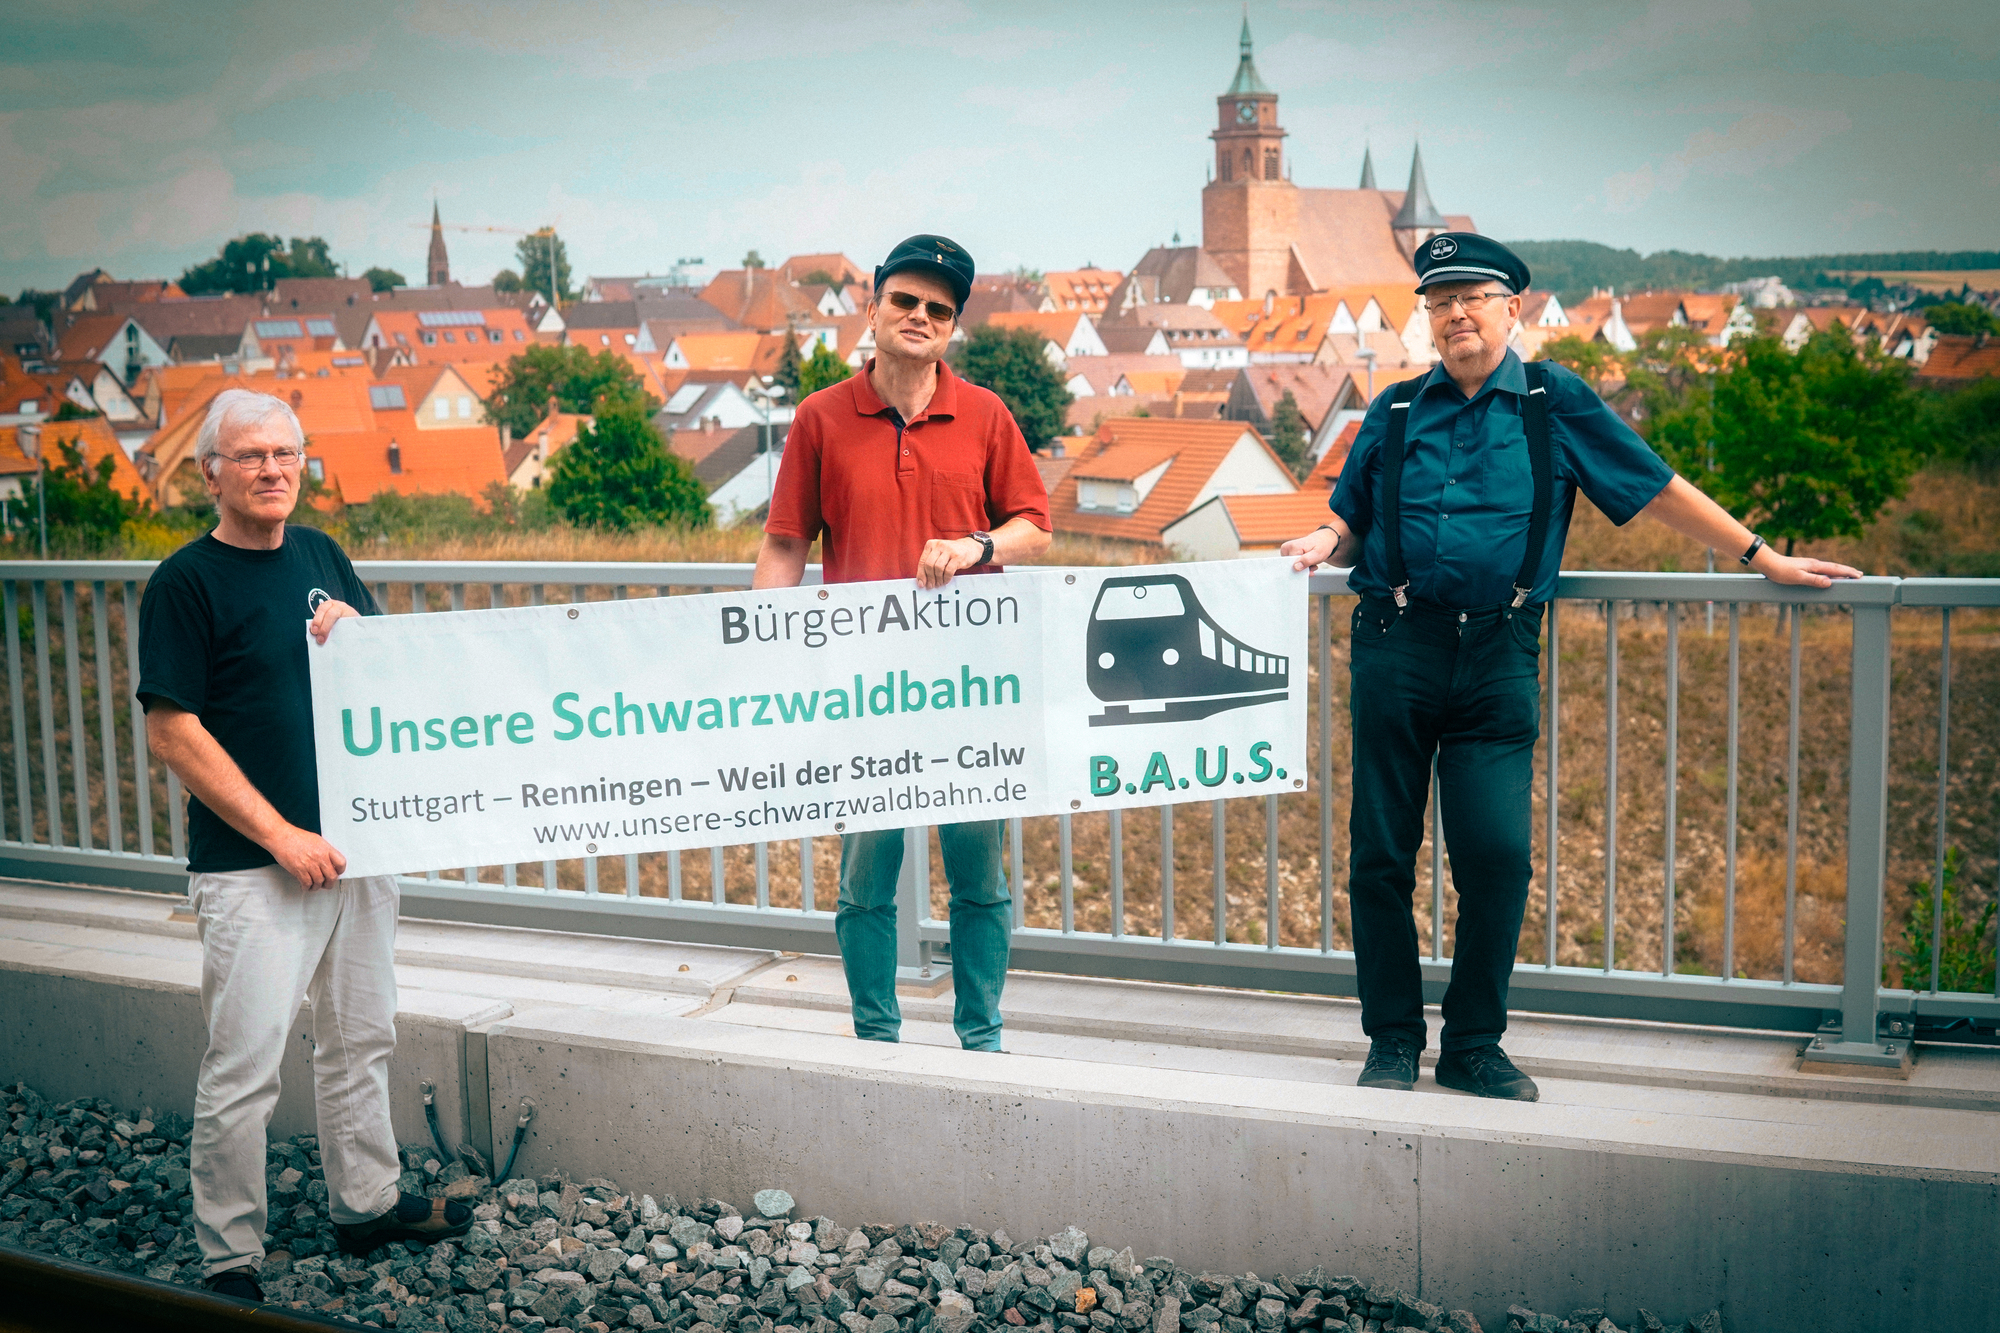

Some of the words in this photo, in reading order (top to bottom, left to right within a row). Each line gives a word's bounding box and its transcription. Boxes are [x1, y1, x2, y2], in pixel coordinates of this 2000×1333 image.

[720, 589, 1019, 649] BürgerAktion
[341, 706, 534, 757] Unsere
[552, 664, 1021, 741] Schwarzwaldbahn
[351, 789, 485, 823] Stuttgart
[521, 776, 682, 808] Renningen
[717, 762, 786, 793] Weil
[795, 759, 843, 787] der
[850, 748, 924, 780] Stadt
[956, 741, 1026, 770] Calw
[1089, 740, 1288, 798] B.A.U.S.
[533, 777, 1027, 844] www.unsere-schwarzwaldbahn.de
